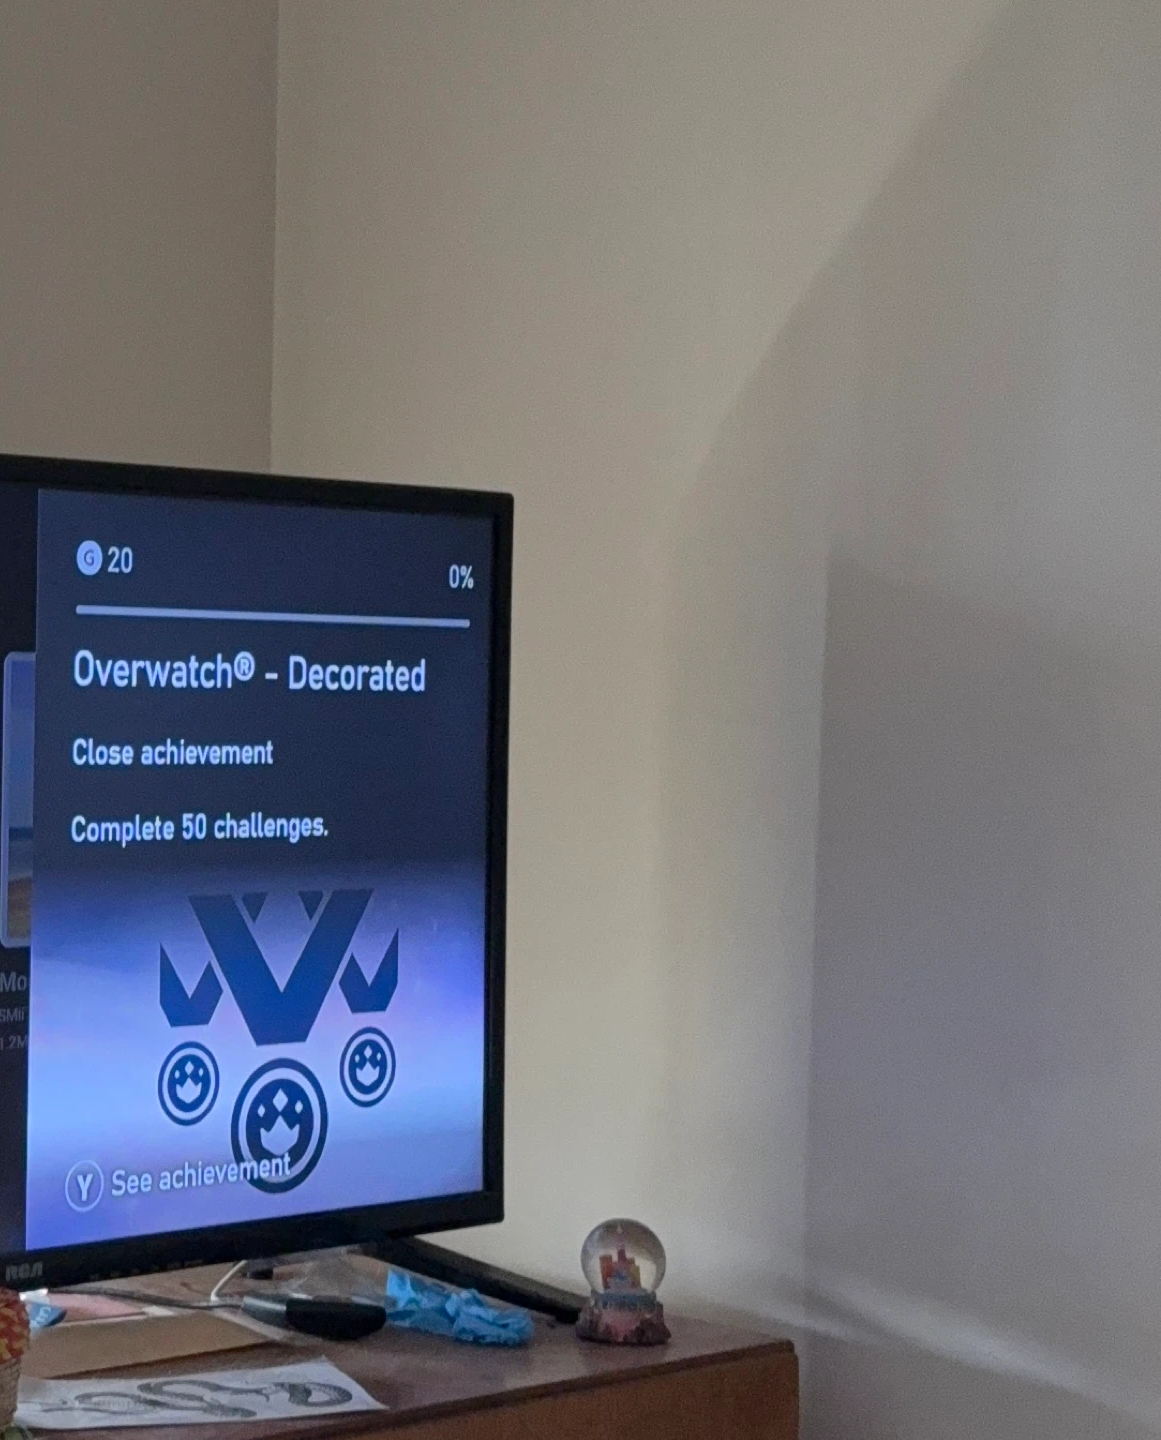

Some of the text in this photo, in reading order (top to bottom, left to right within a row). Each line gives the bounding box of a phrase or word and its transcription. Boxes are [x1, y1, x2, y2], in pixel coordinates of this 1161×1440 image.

[107, 546, 133, 574] 20
[449, 565, 474, 589] 0%
[289, 655, 426, 692] Decorated
[72, 738, 274, 766] Close achievement
[71, 813, 329, 848] Complete 50 challenges.
[111, 1169, 152, 1197] See
[159, 1154, 291, 1190] achievement
